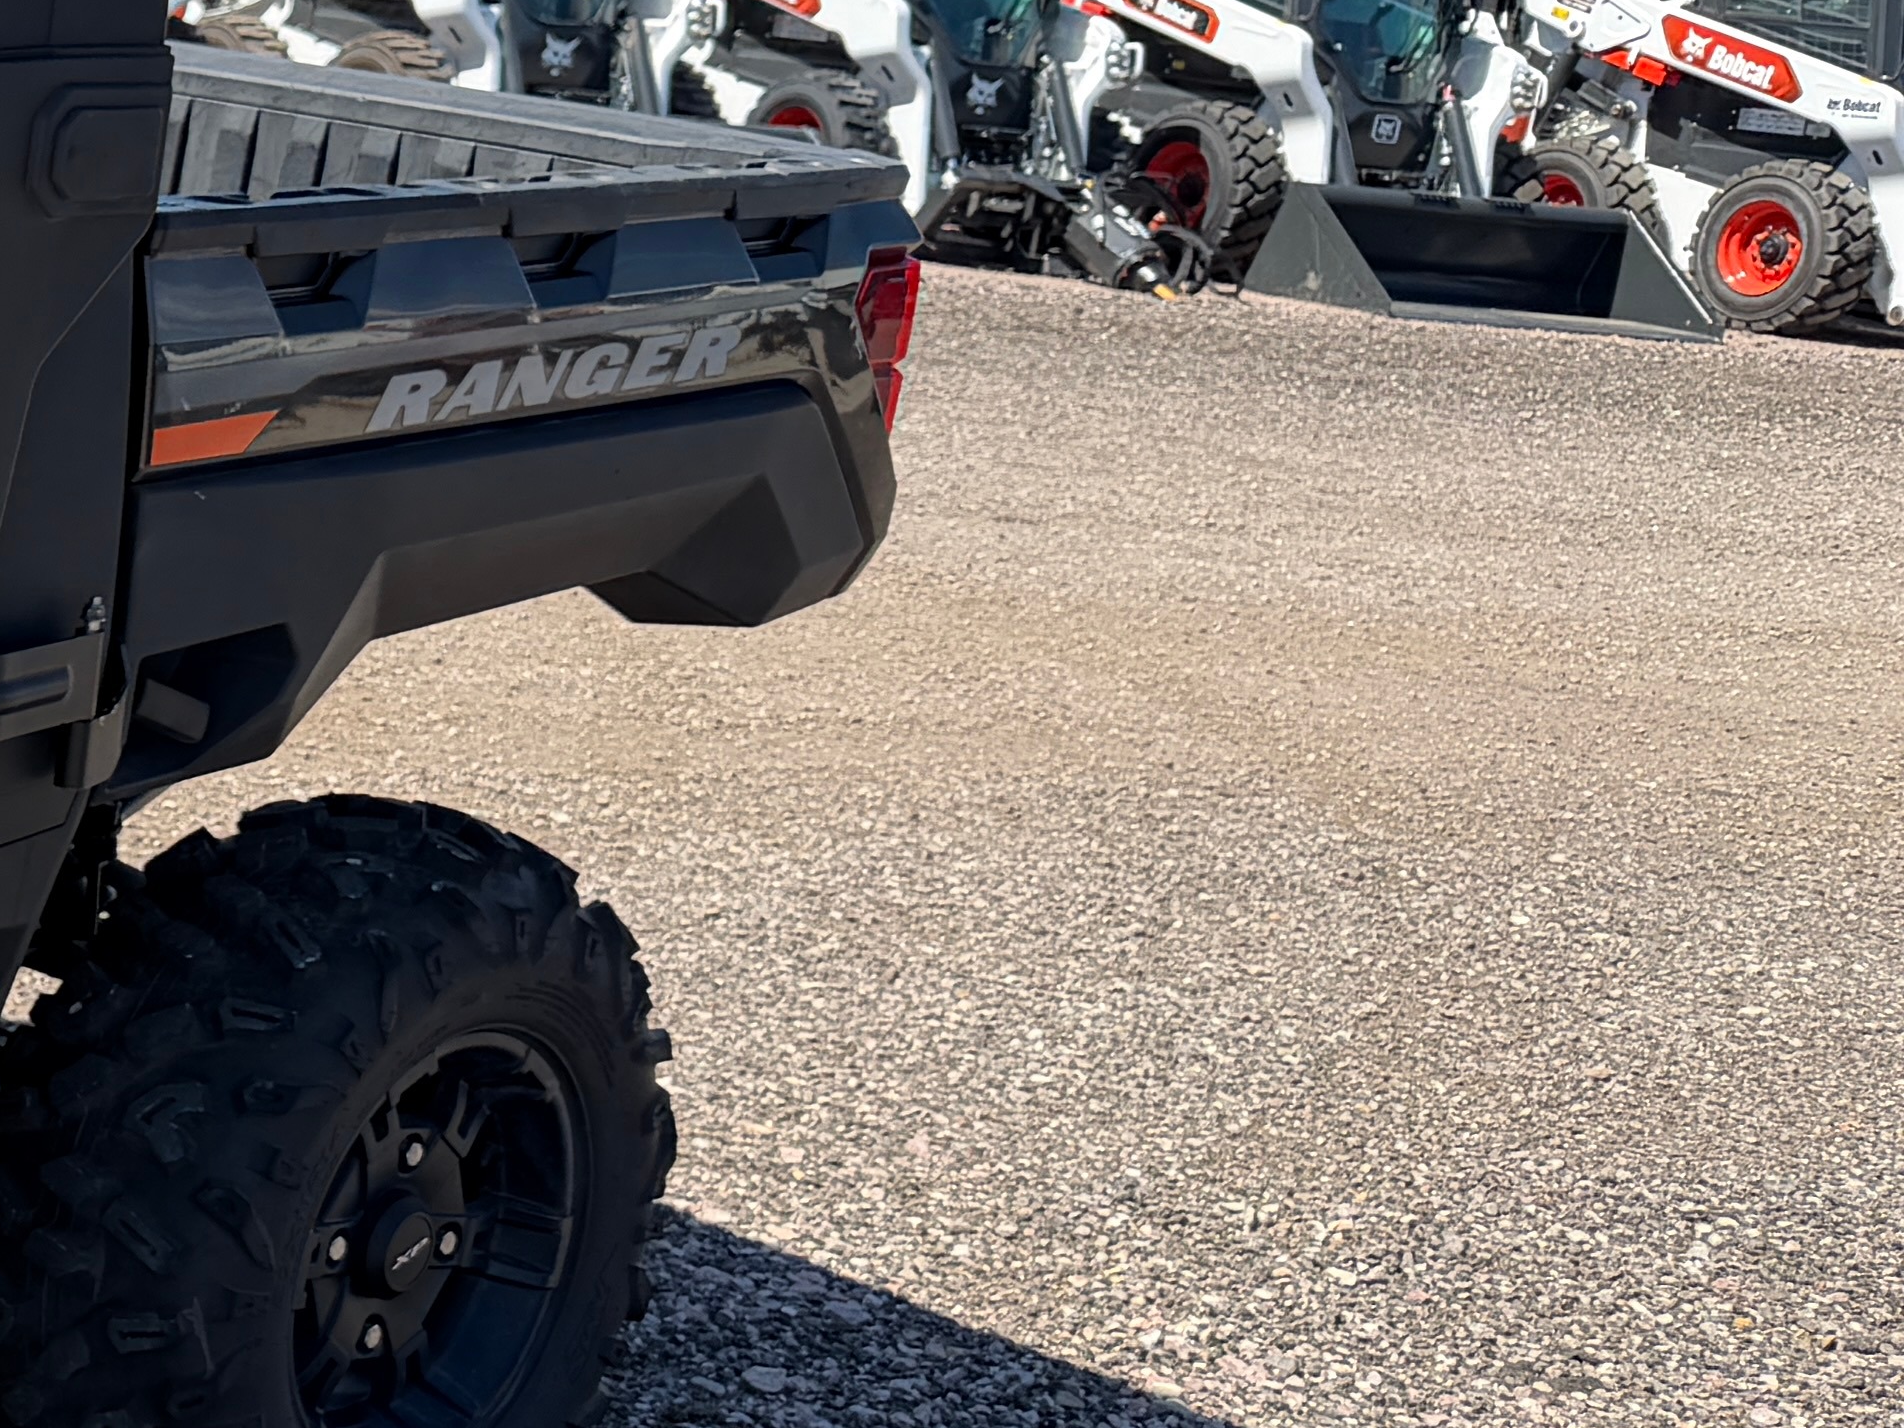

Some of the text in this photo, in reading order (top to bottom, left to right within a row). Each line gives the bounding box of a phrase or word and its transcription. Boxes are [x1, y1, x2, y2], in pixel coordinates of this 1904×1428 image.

[1707, 44, 1775, 90] Bobcat
[1842, 98, 1881, 113] Bobcat
[365, 325, 741, 433] RANGER
